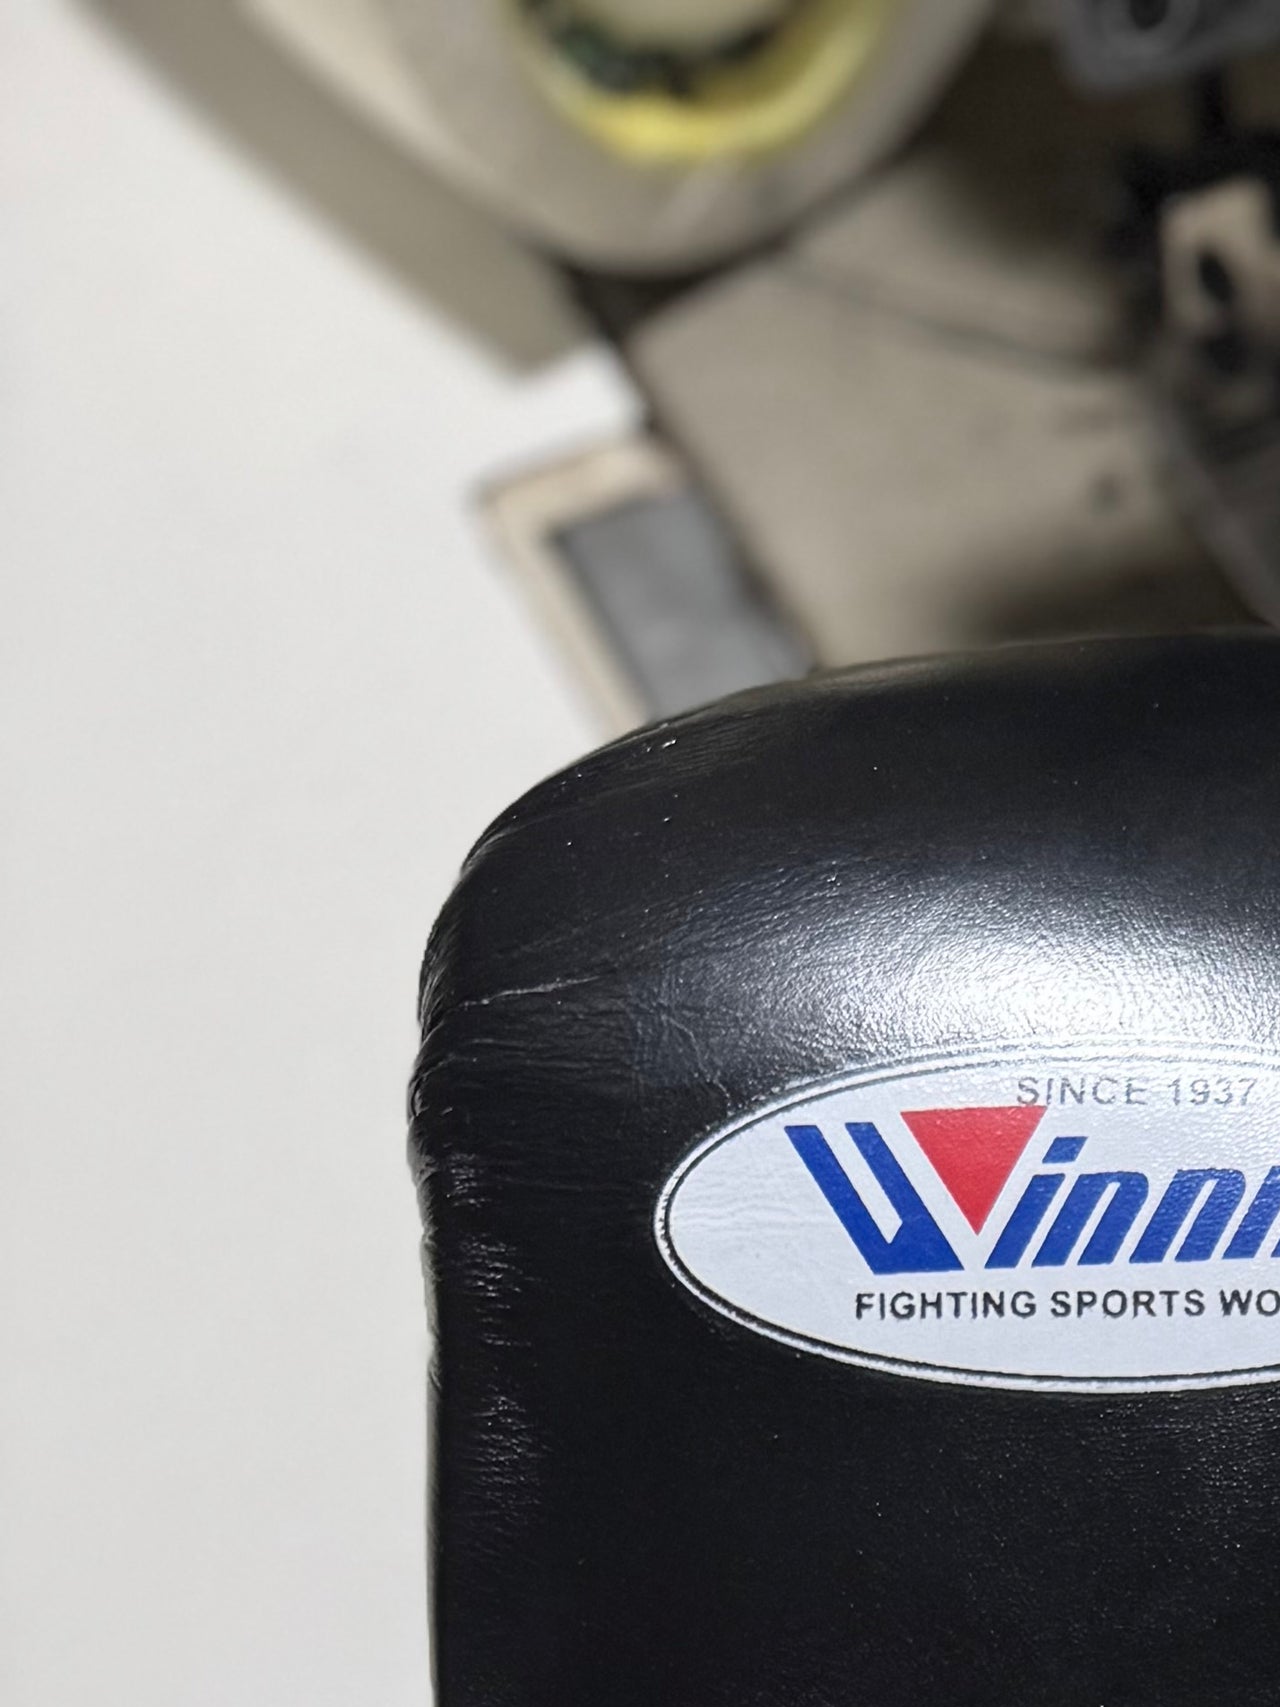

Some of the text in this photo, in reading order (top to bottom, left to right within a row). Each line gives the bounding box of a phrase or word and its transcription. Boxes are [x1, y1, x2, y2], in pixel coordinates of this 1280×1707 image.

[1016, 1075, 1258, 1108] SINCE 1937
[854, 1289, 1038, 1321] FIGHTING
[1050, 1288, 1206, 1319] SPORTS
